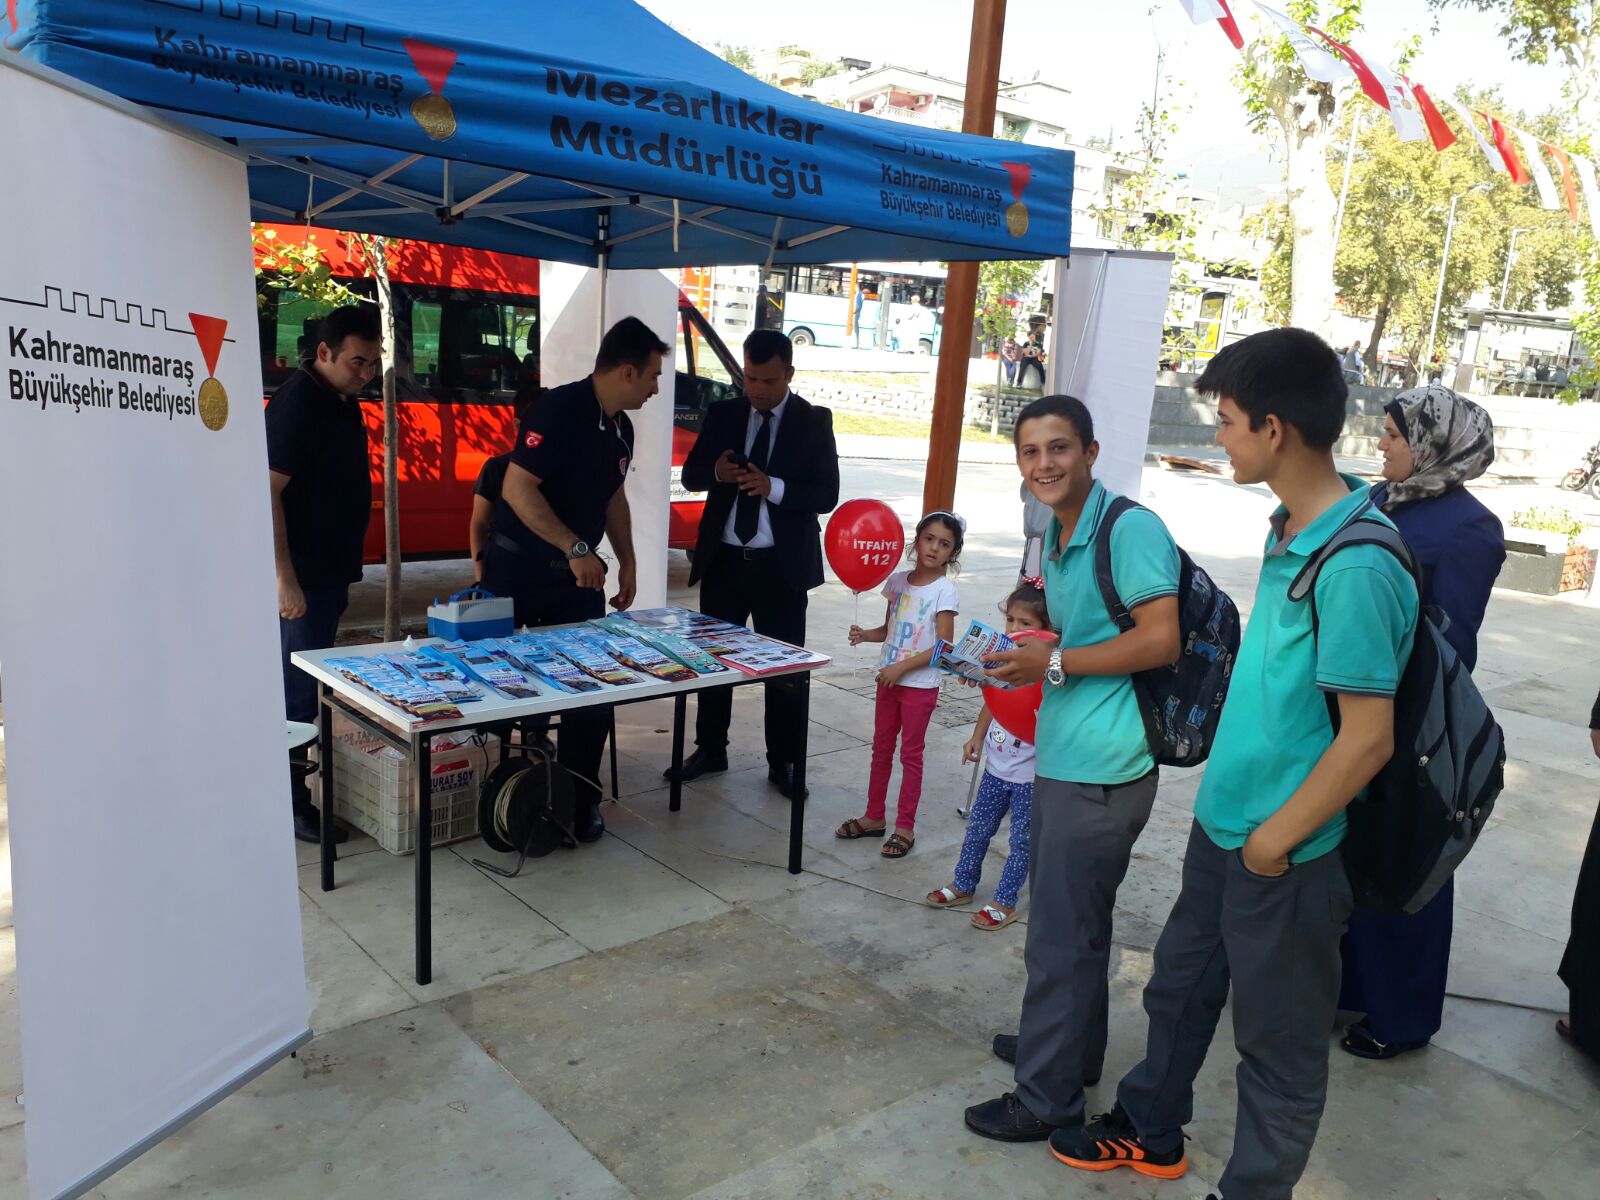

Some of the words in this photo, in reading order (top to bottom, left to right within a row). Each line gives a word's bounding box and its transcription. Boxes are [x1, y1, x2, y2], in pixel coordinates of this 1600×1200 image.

[155, 27, 404, 97] Kahramanmaraş
[292, 80, 402, 120] Belediyesi
[544, 66, 824, 145] Mezarlıklar
[550, 114, 823, 200] Müdürlüğü
[881, 163, 1003, 207] Kahramanmaraş
[880, 190, 944, 221] Büyükşehir
[947, 202, 1001, 230] Belediyesi
[9, 326, 194, 387] Kahramanmaraş
[9, 368, 114, 414] Büyükşehir
[118, 381, 196, 421] Belediyesi
[853, 538, 898, 551] İTFAİYE
[860, 553, 890, 566] 112
[457, 769, 474, 782] SOY
